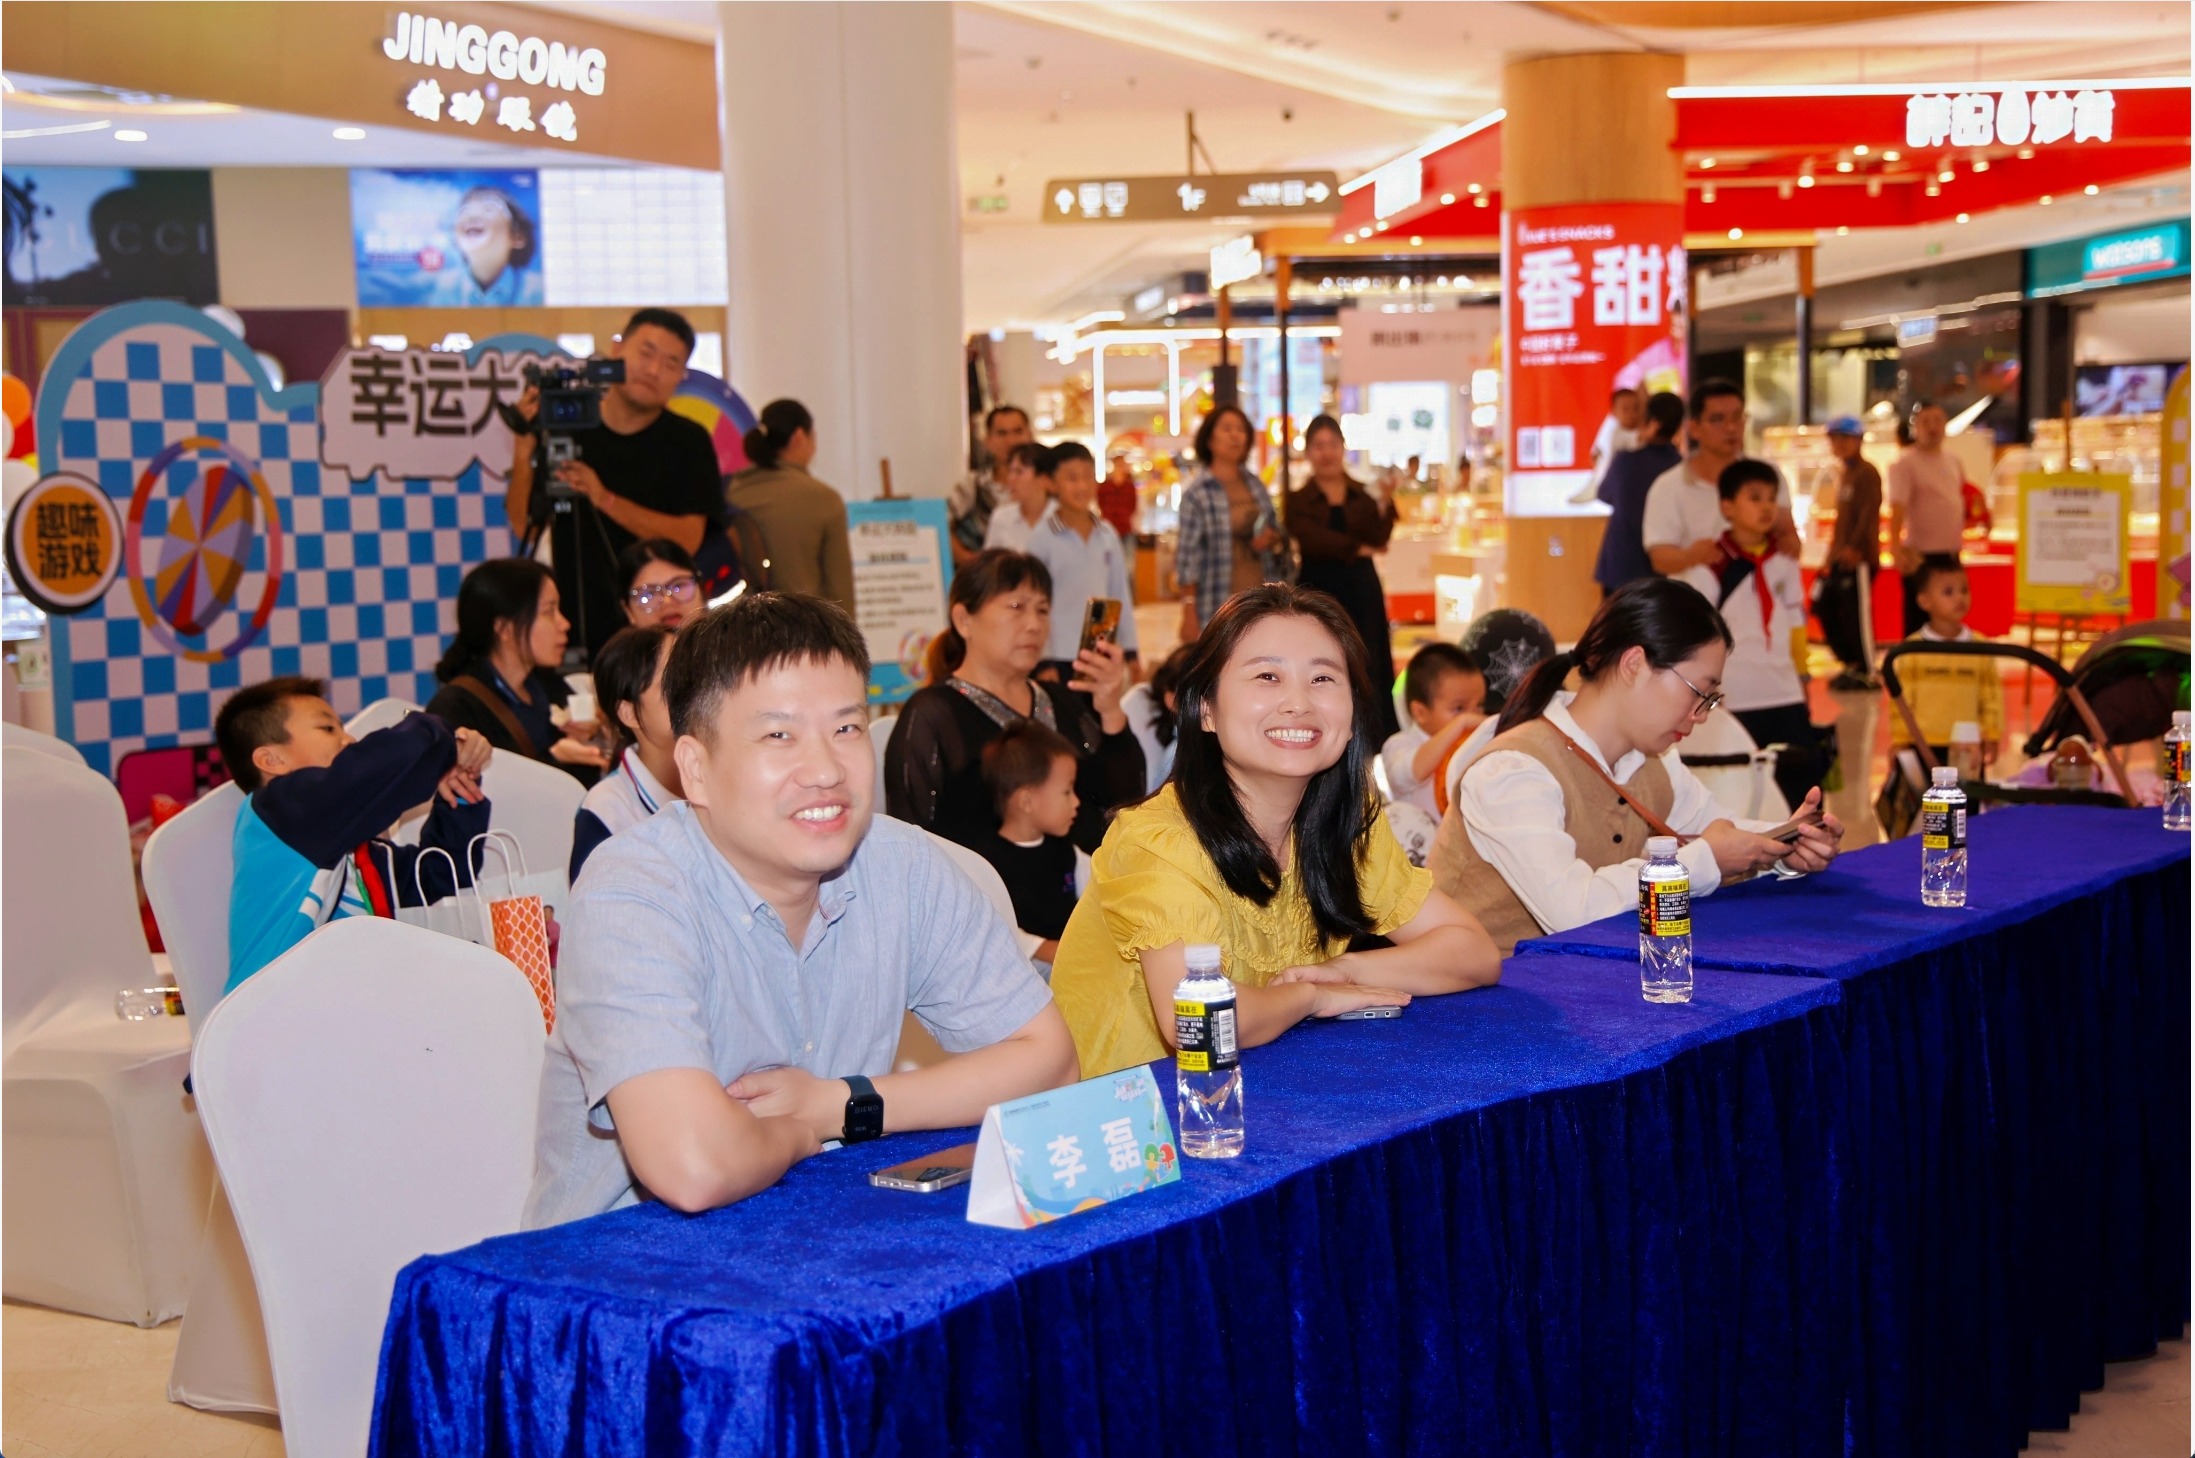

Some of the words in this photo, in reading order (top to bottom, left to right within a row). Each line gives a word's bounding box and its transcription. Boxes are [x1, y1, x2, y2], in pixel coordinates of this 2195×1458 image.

[383, 12, 607, 96] JINGGONG
[351, 355, 522, 436] 幸运大
[37, 502, 100, 541] 趣味
[38, 541, 103, 581] 游戏
[1046, 1116, 1142, 1189] 李磊
